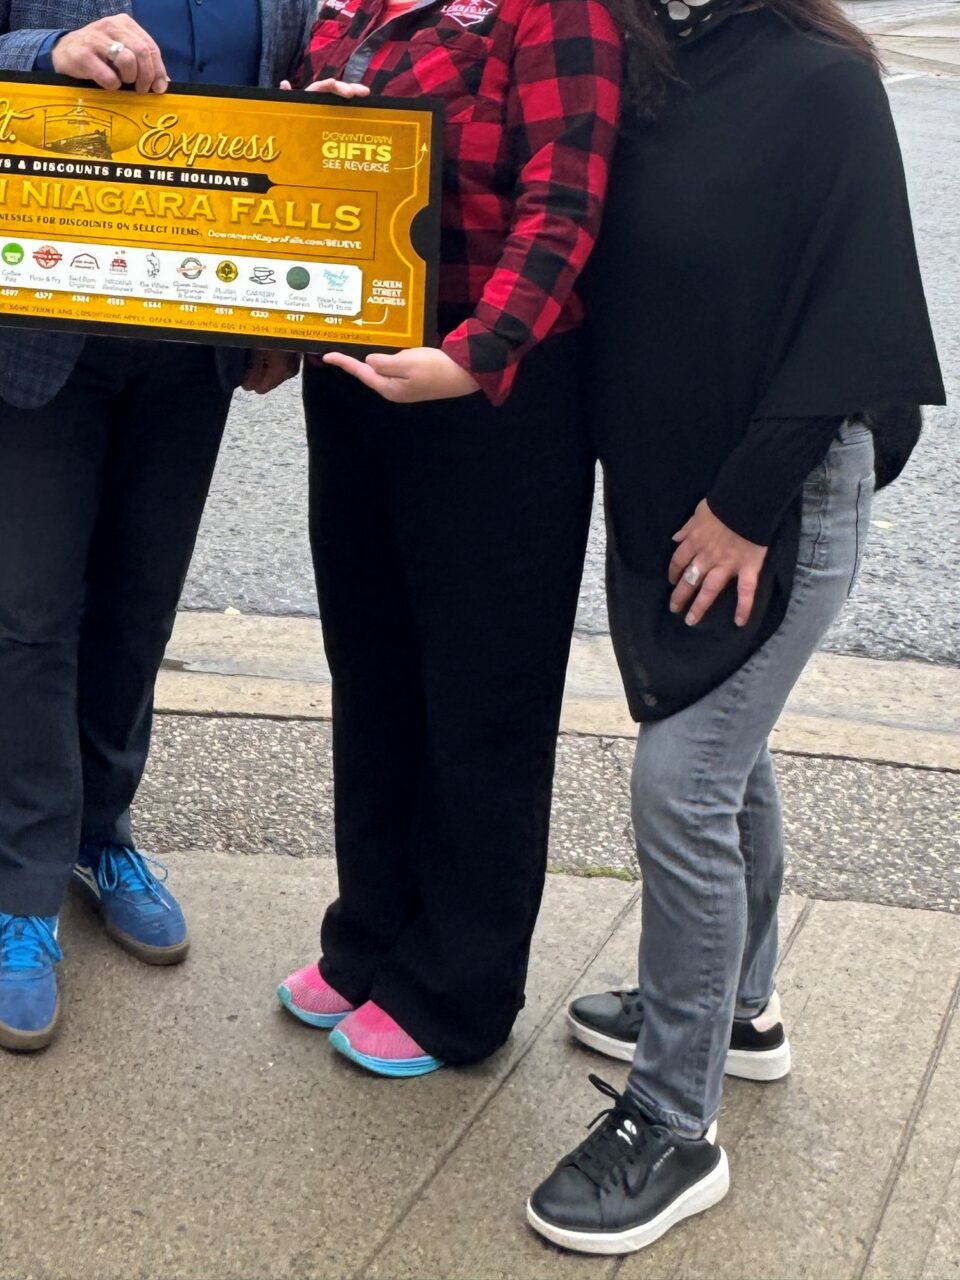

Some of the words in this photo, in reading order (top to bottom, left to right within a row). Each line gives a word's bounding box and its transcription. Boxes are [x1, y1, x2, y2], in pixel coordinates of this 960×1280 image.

[138, 112, 281, 166] Express
[321, 141, 392, 163] GIFTS
[33, 162, 110, 177] DISCOUNTS
[116, 167, 142, 179] FOR
[149, 170, 174, 181] THE
[180, 174, 249, 187] HOLIDAYS
[322, 158, 341, 169] SEE
[344, 161, 390, 173] REVERSE
[21, 181, 217, 221] NIAGARA
[229, 197, 362, 232] FALLS
[37, 215, 56, 225] FOR
[59, 217, 113, 230] DISCOUNTS
[117, 221, 130, 231] ON
[133, 223, 167, 234] SELECT
[372, 279, 403, 288] QUEEN
[366, 296, 406, 307] ADDRESS
